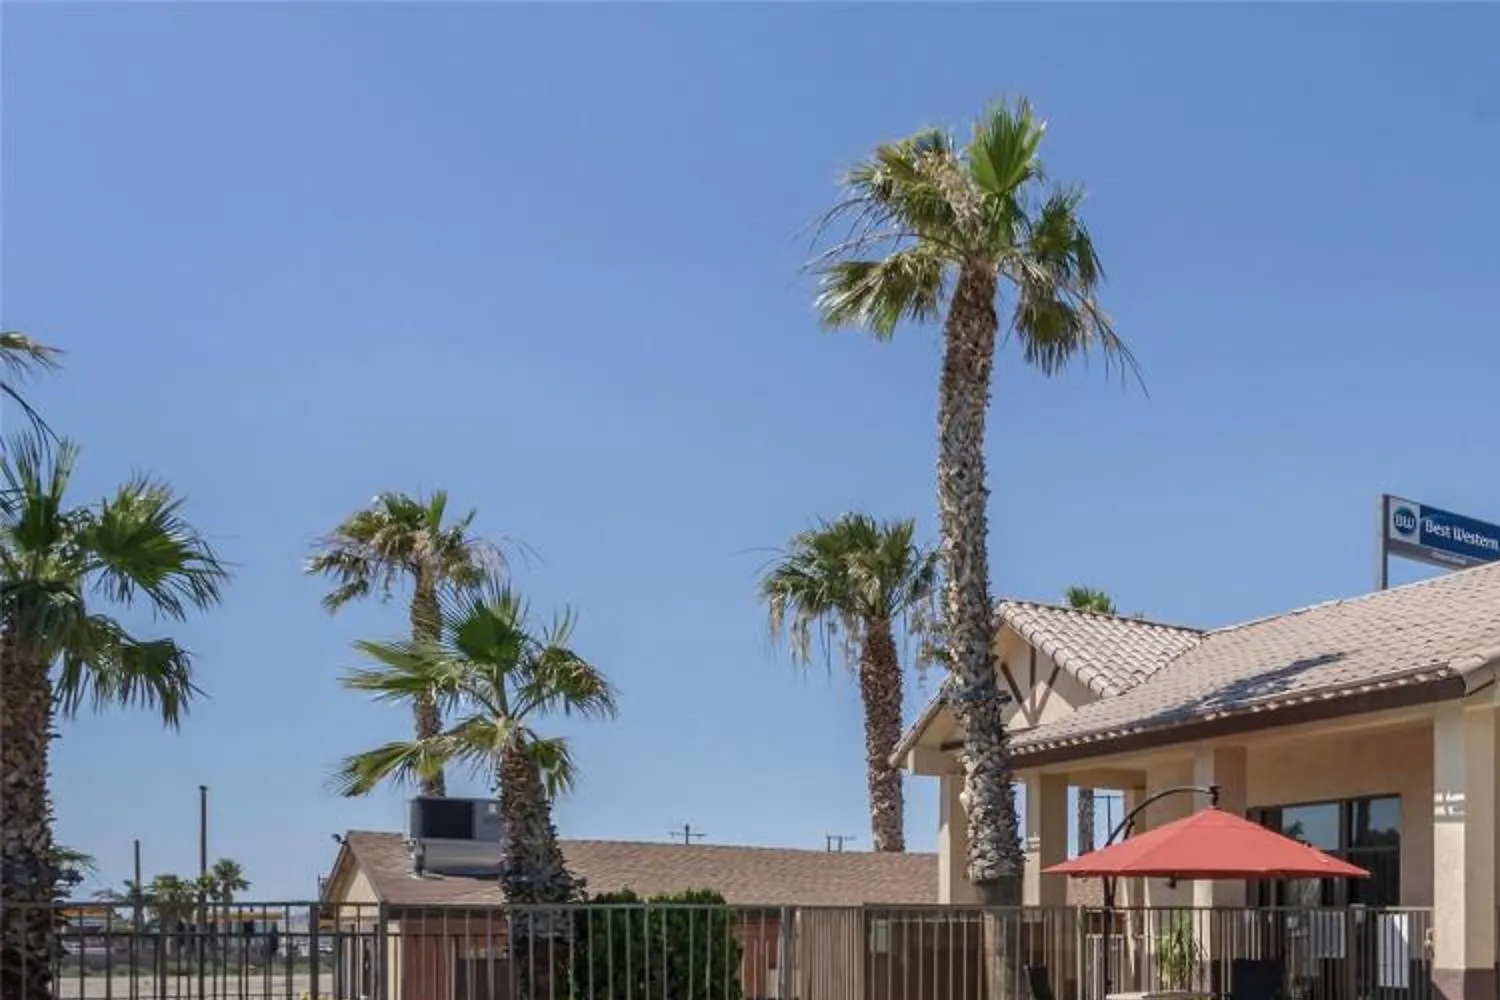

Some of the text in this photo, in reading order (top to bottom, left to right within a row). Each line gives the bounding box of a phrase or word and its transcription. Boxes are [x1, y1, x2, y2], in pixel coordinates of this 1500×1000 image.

[1395, 513, 1415, 529] BW
[1425, 519, 1499, 551] Best Western
